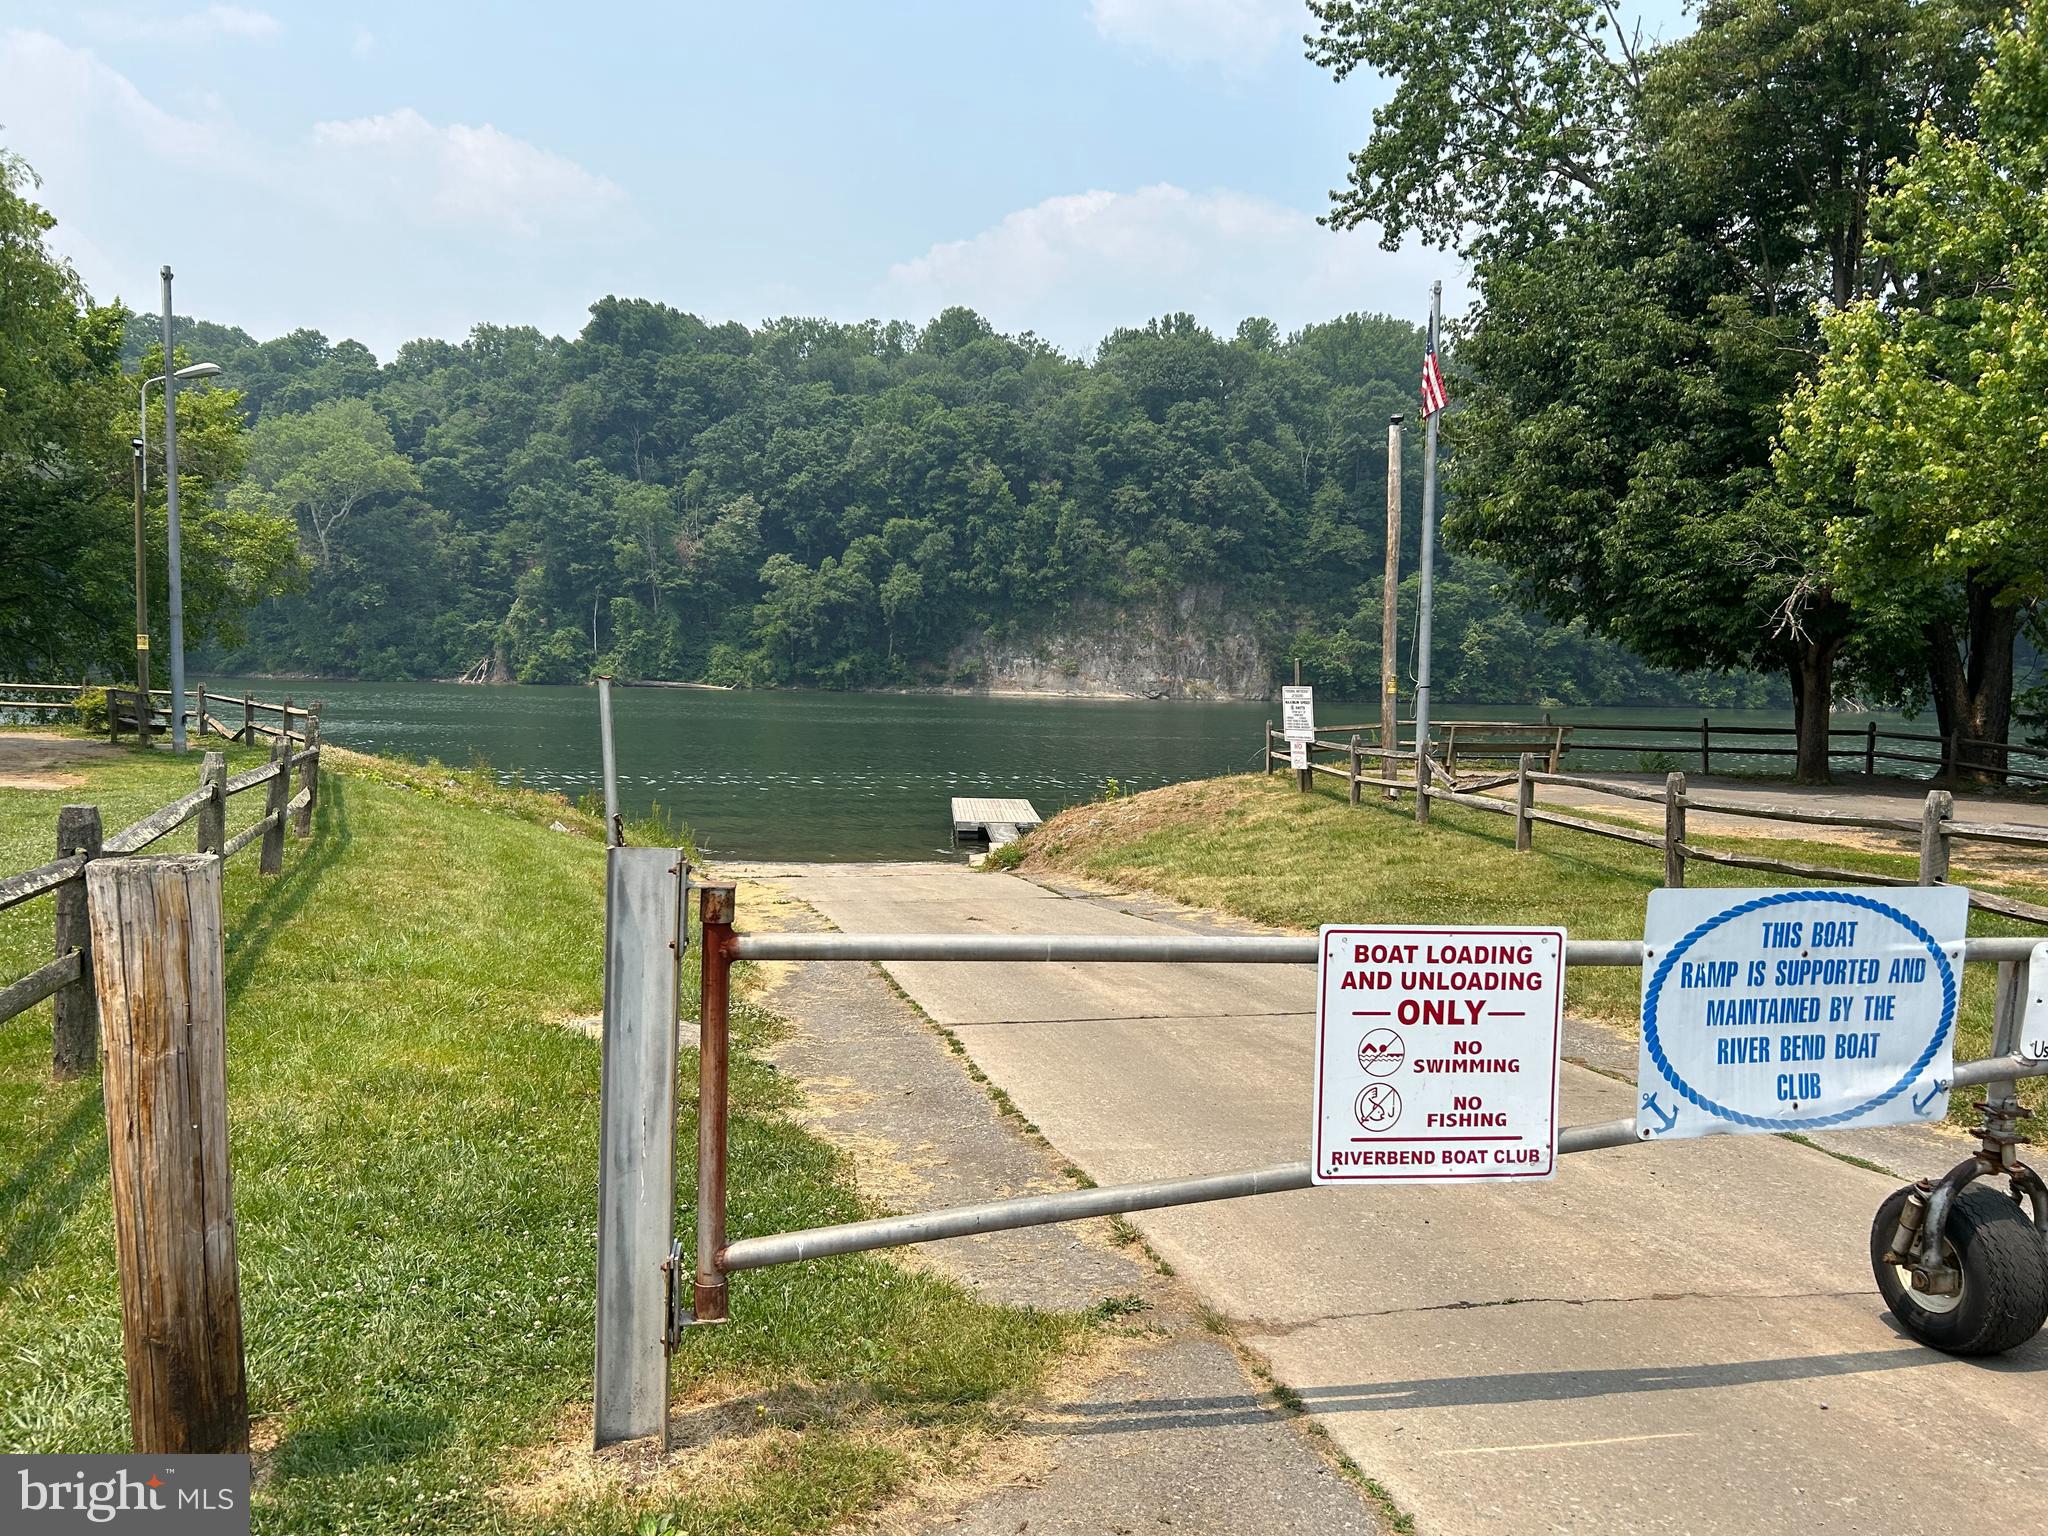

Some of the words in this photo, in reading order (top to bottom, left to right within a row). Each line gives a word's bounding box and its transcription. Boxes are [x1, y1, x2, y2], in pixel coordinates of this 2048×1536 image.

[1762, 922, 1802, 948] THIS
[1811, 921, 1858, 947] BOAT
[1354, 945, 1418, 963] BOAT
[1427, 946, 1532, 964] LOADING
[1341, 971, 1391, 989] AND
[1401, 972, 1541, 990] UNLOADING
[1681, 962, 1738, 988] RAMP
[1747, 961, 1766, 986] IS
[1775, 958, 1880, 985] SUPPORTED
[1888, 958, 1926, 983] AND
[1397, 999, 1487, 1025] ONLY
[1707, 998, 1820, 1026] MAINTAINED
[1829, 996, 1854, 1022] BY
[1864, 995, 1895, 1020] THE
[1454, 1041, 1482, 1054] NO
[1717, 1037, 1769, 1064] RIVER
[1780, 1034, 1825, 1062] BEND
[1835, 1033, 1880, 1058] BOAT
[1413, 1059, 1520, 1073] SWIMMING
[1777, 1073, 1821, 1100] CLUB
[1454, 1096, 1482, 1110] NO
[1427, 1113, 1507, 1127] FISHING
[1332, 1151, 1435, 1165] RIVERBEND
[1442, 1150, 1488, 1164] BOAT
[1494, 1149, 1540, 1162] CLUB
